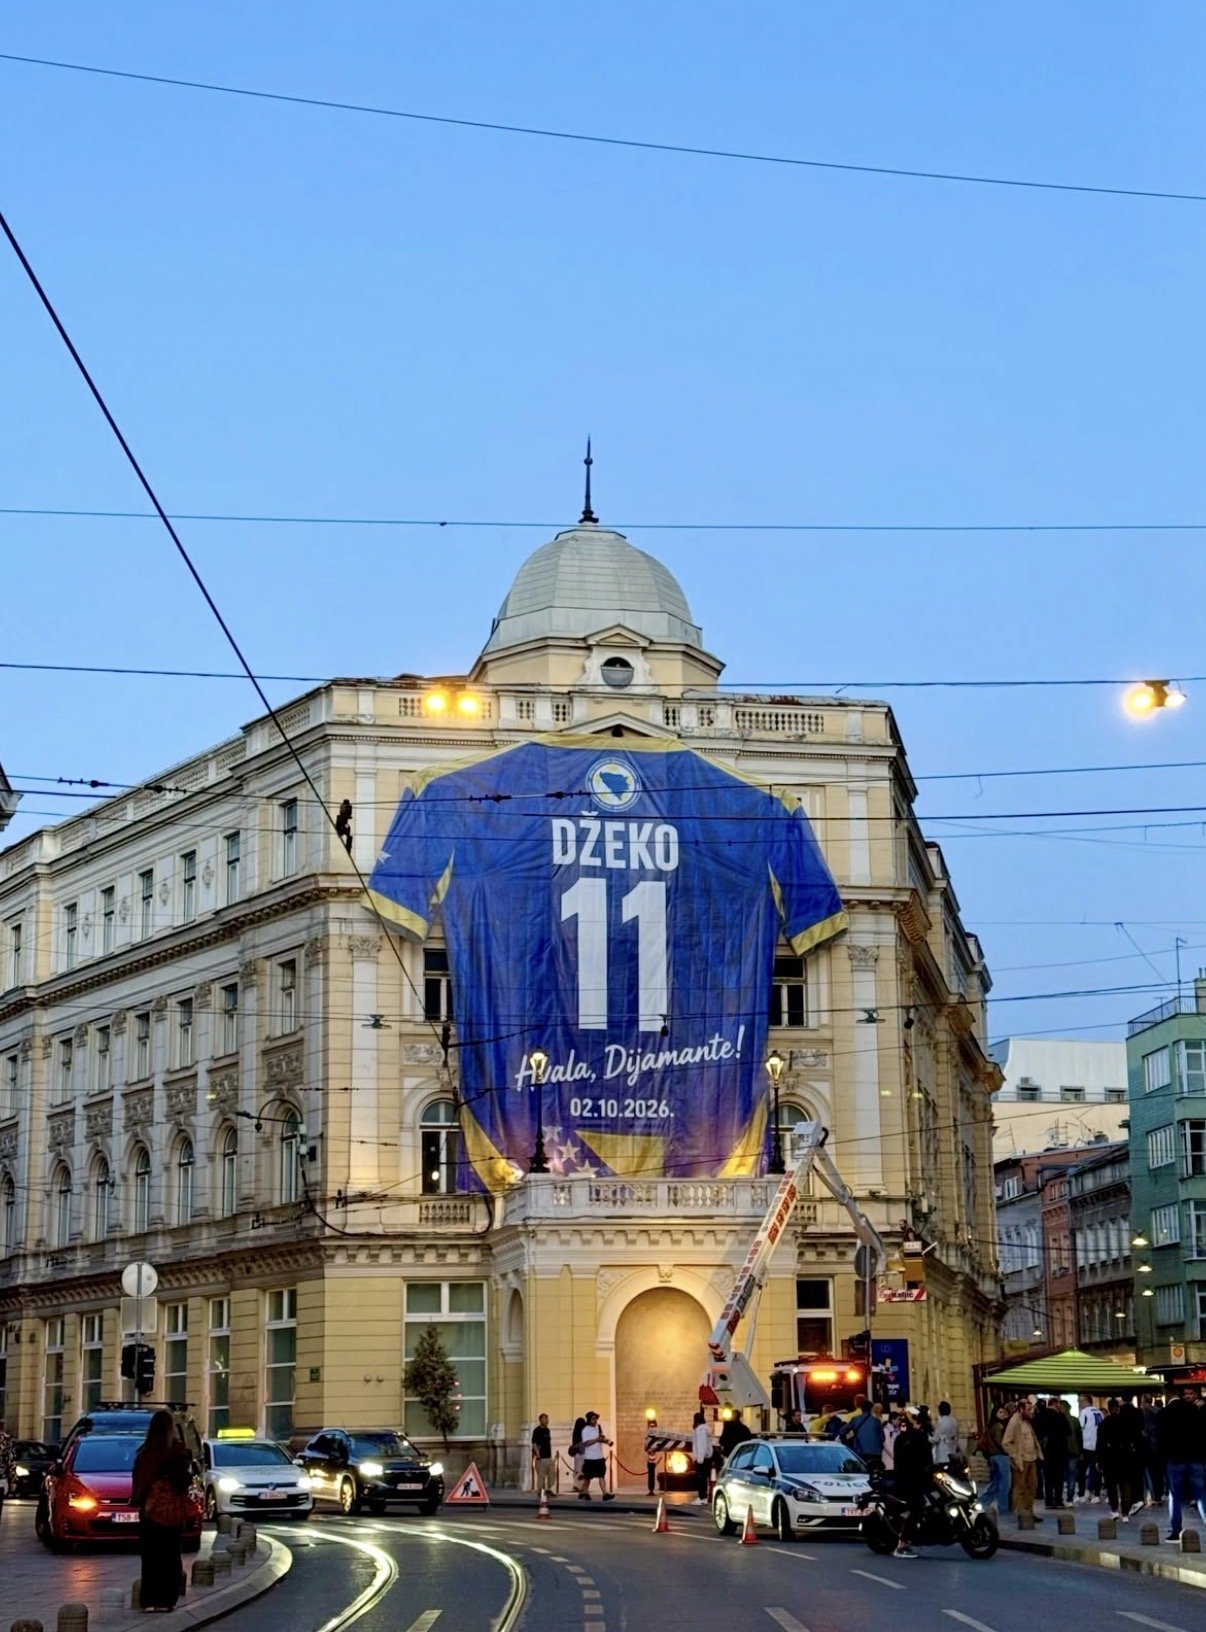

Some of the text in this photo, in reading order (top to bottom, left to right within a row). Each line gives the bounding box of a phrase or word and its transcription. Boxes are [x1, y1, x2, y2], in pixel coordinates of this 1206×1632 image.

[552, 811, 679, 871] DŽEKO
[561, 877, 667, 1031] 11
[515, 1025, 745, 1092] Hvala, Dijamante!
[569, 1097, 676, 1119] 02.10.2026.
